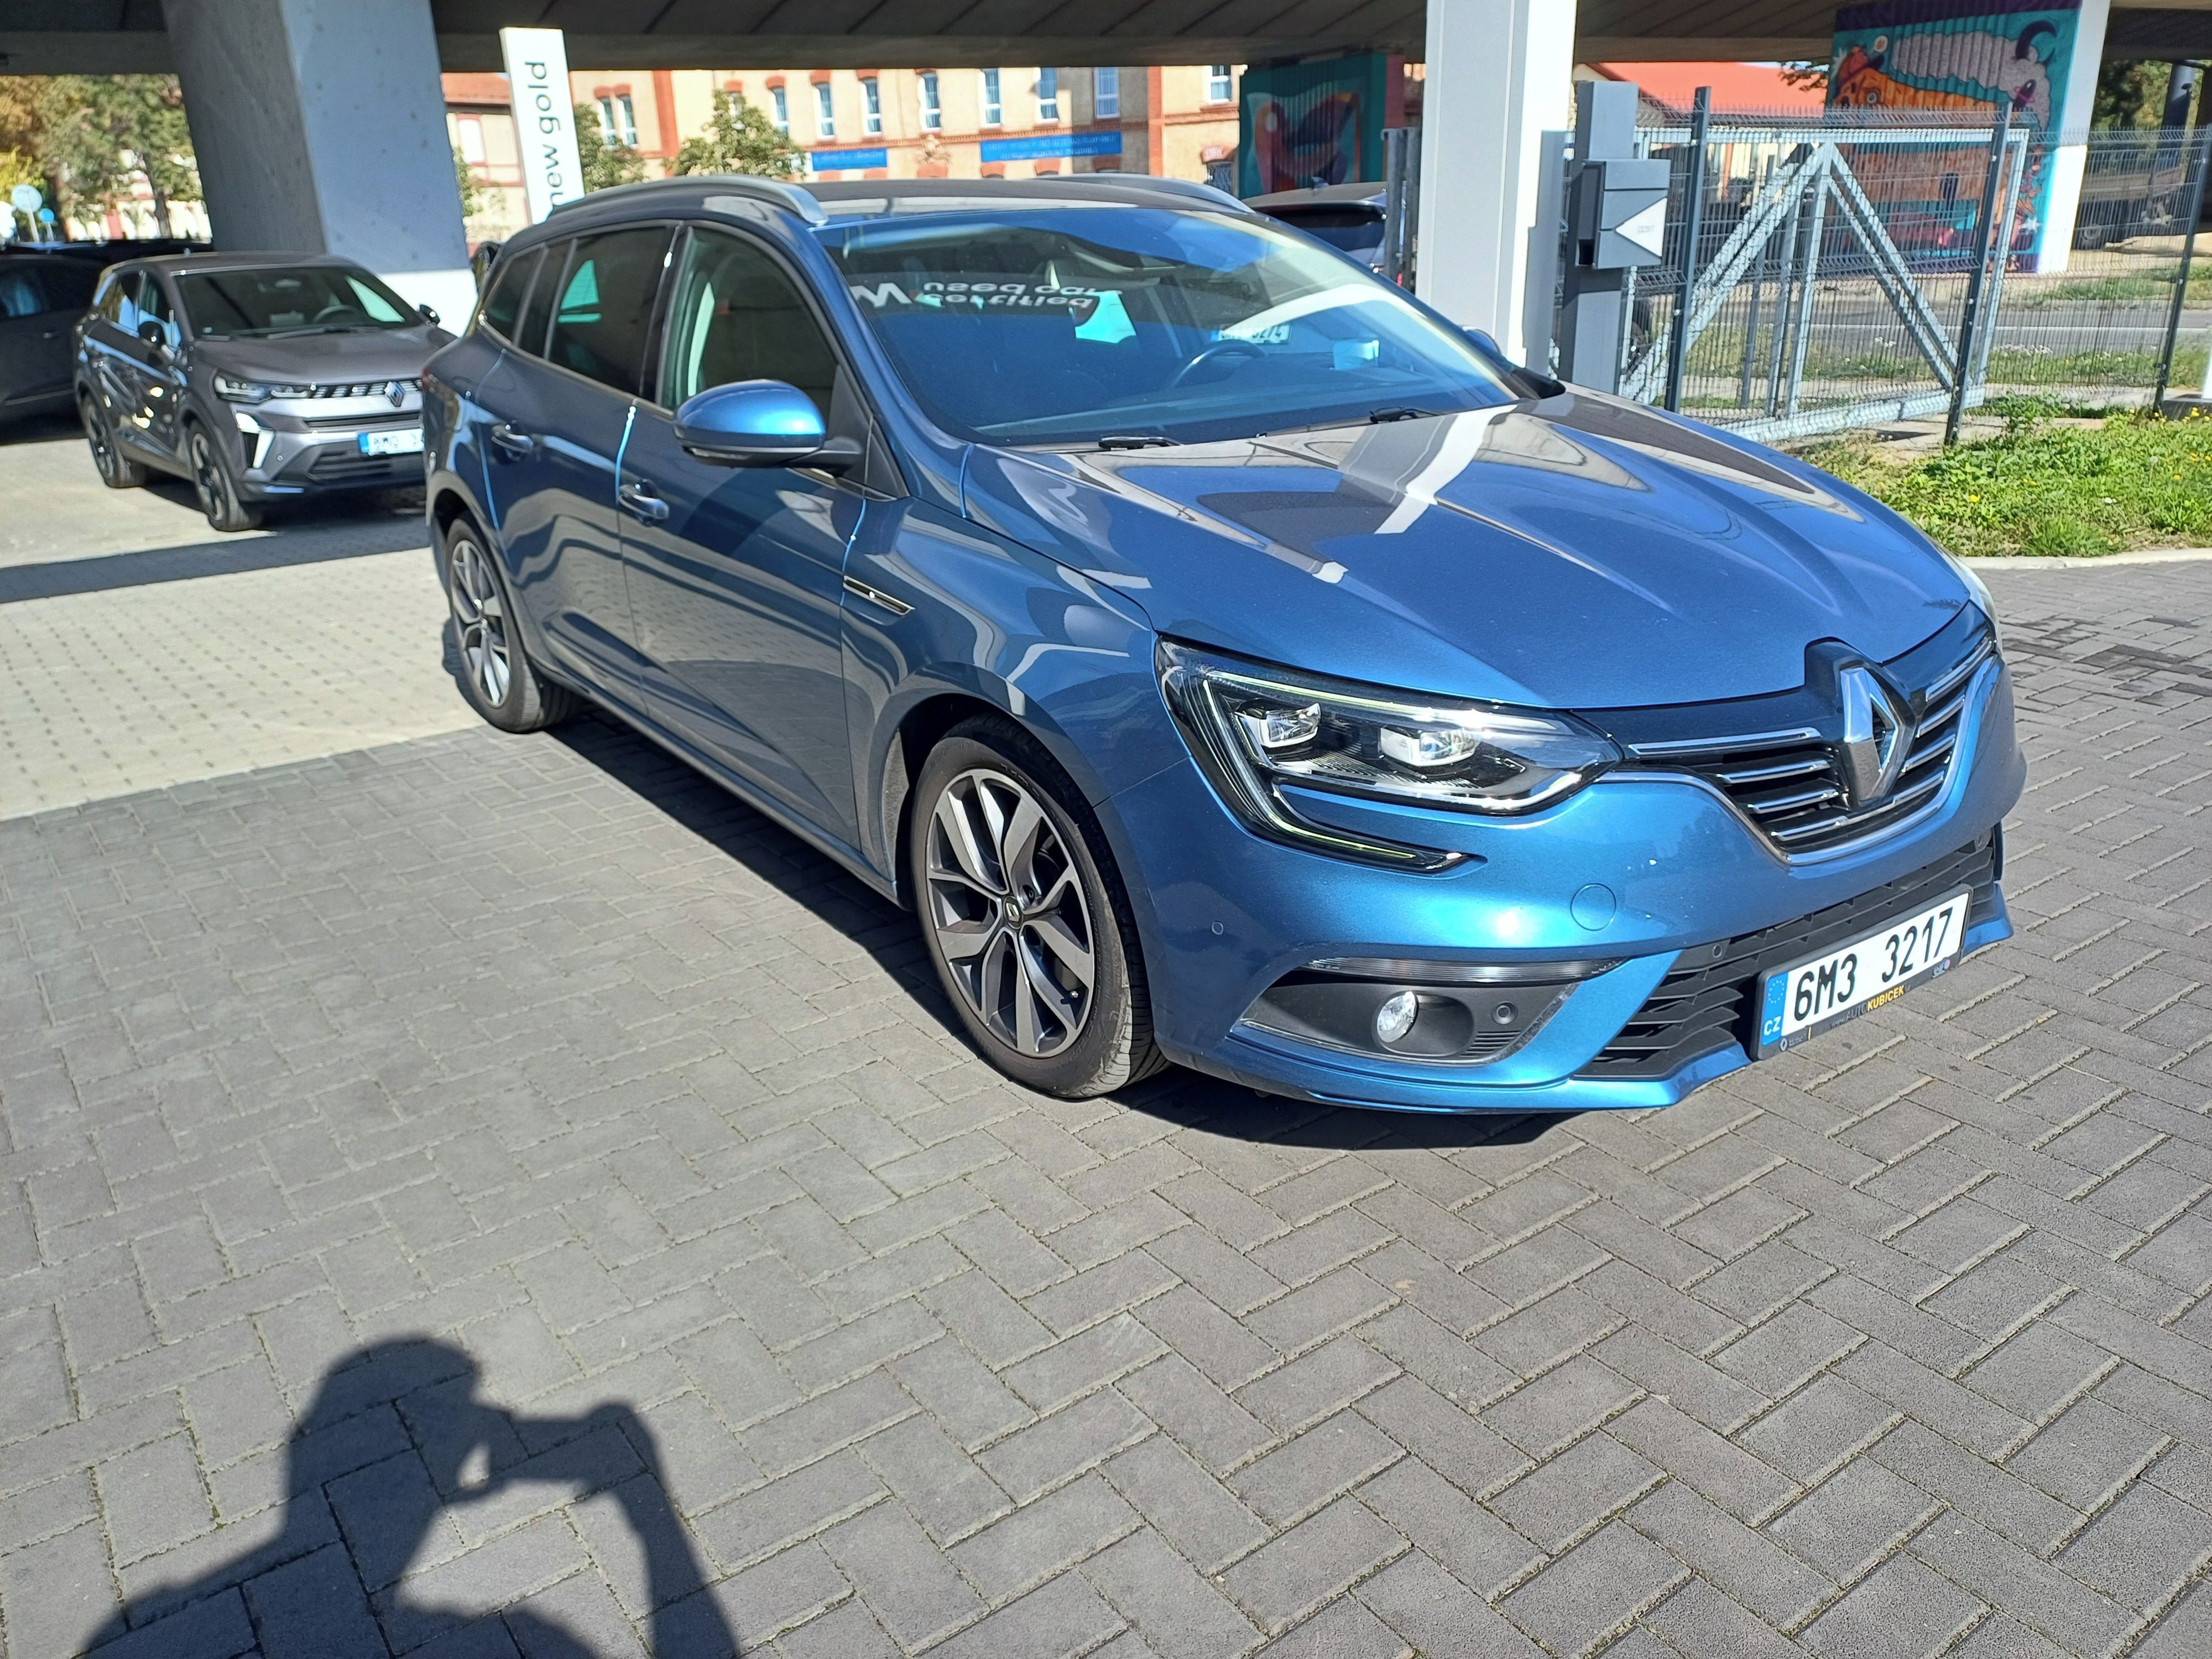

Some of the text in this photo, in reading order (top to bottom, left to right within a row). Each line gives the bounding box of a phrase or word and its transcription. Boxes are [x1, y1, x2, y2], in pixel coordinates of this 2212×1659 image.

[524, 61, 561, 134] gold
[1794, 906, 1954, 1021] 6M3 3217
[1764, 1016, 1781, 1036] CZ
